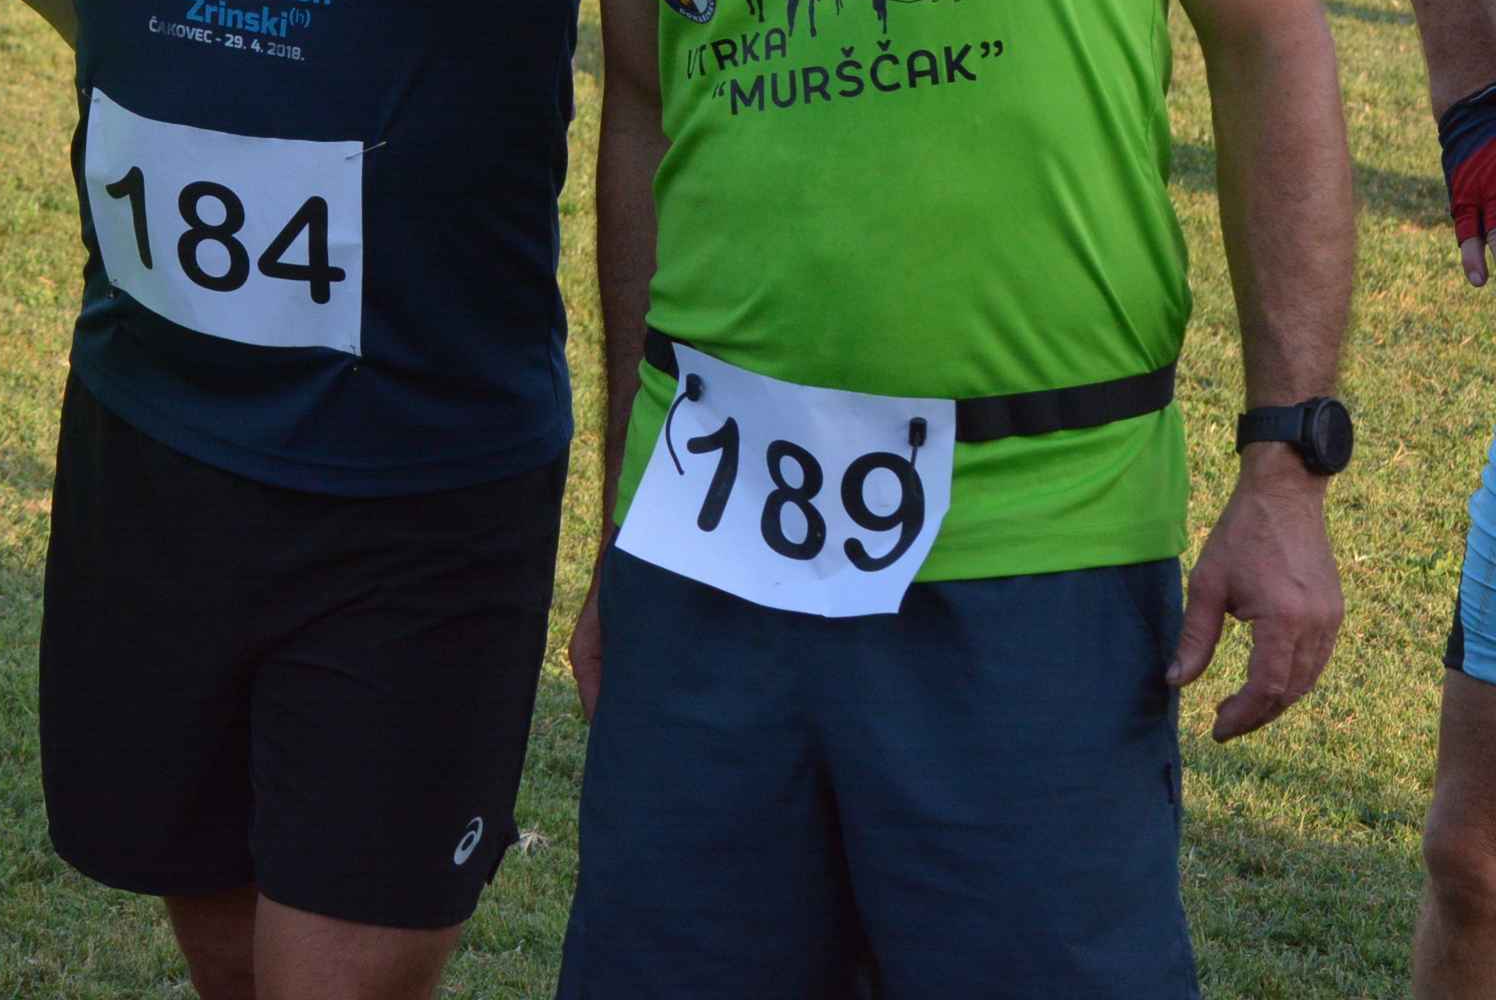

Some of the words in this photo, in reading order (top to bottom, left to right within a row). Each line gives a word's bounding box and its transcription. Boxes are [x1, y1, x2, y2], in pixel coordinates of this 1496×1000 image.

[148, 16, 212, 43] ČAKOVEC
[224, 33, 247, 50] 29.
[251, 39, 264, 53] 4.
[267, 42, 305, 61] 2018.
[105, 166, 346, 304] 184
[687, 416, 925, 573] 189
